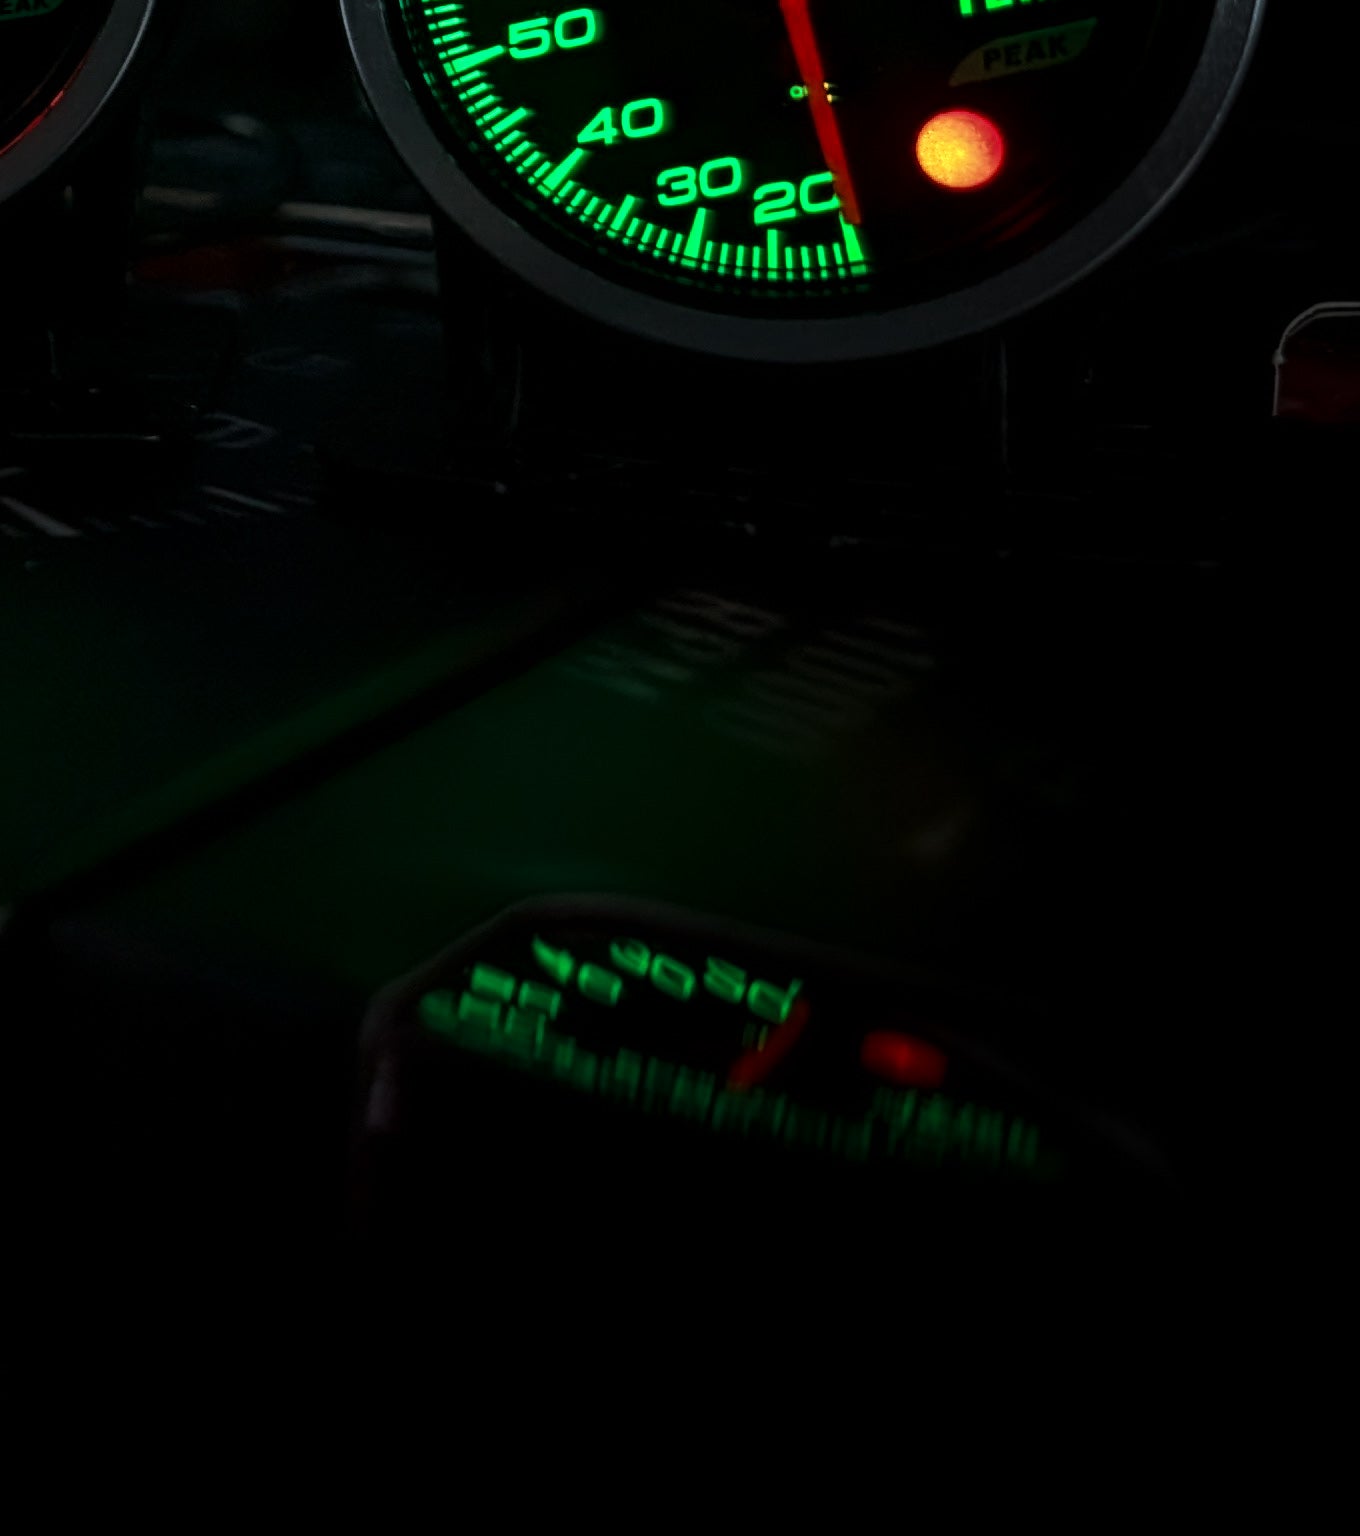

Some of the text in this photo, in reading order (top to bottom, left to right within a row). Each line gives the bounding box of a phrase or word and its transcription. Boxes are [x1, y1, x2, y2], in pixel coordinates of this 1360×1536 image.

[507, 7, 598, 60] 50
[981, 28, 1072, 73] PEAK
[576, 98, 665, 145] 40
[656, 156, 742, 209] 30
[754, 172, 842, 225] 20
